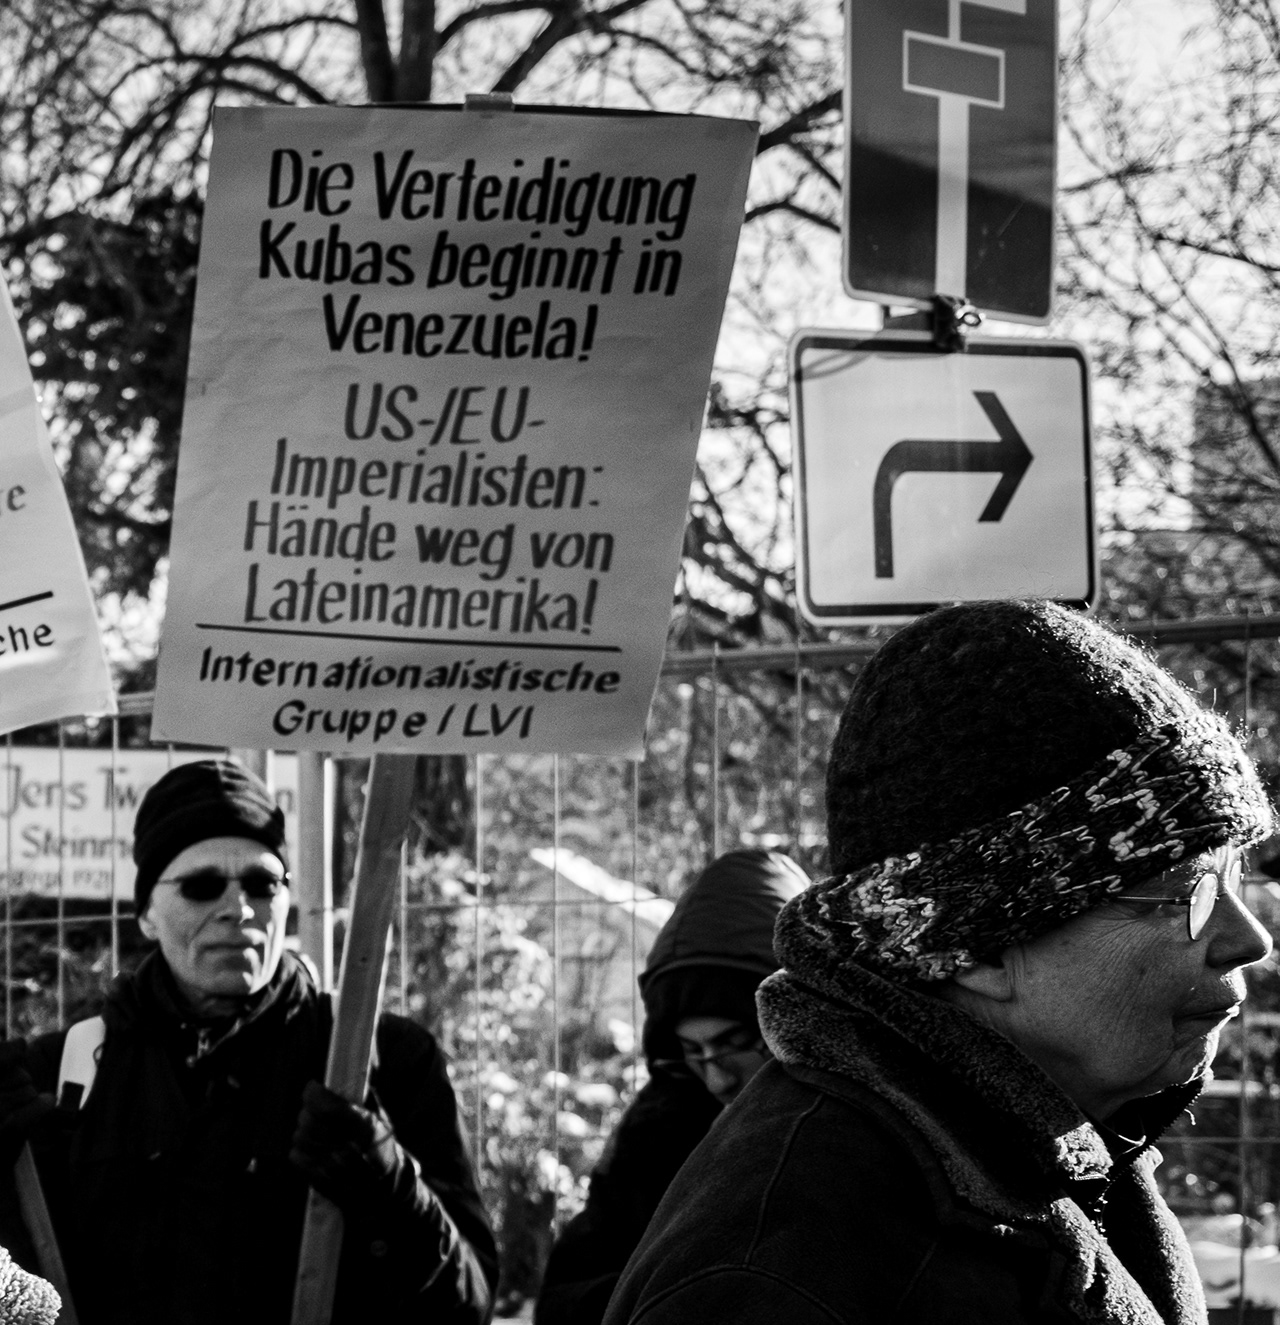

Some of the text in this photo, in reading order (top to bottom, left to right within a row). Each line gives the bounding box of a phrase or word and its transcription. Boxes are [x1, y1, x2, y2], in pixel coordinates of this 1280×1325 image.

[267, 148, 697, 241] Die Verteidigung
[258, 219, 683, 302] Kubas beginnt in
[323, 294, 599, 362] Venezuela!
[270, 438, 604, 510] Imperialisten:
[244, 499, 614, 581] Hände weg von
[244, 563, 599, 636] Lateinamerika!
[200, 647, 621, 694] Internationalistische
[273, 700, 428, 741] Gruppe
